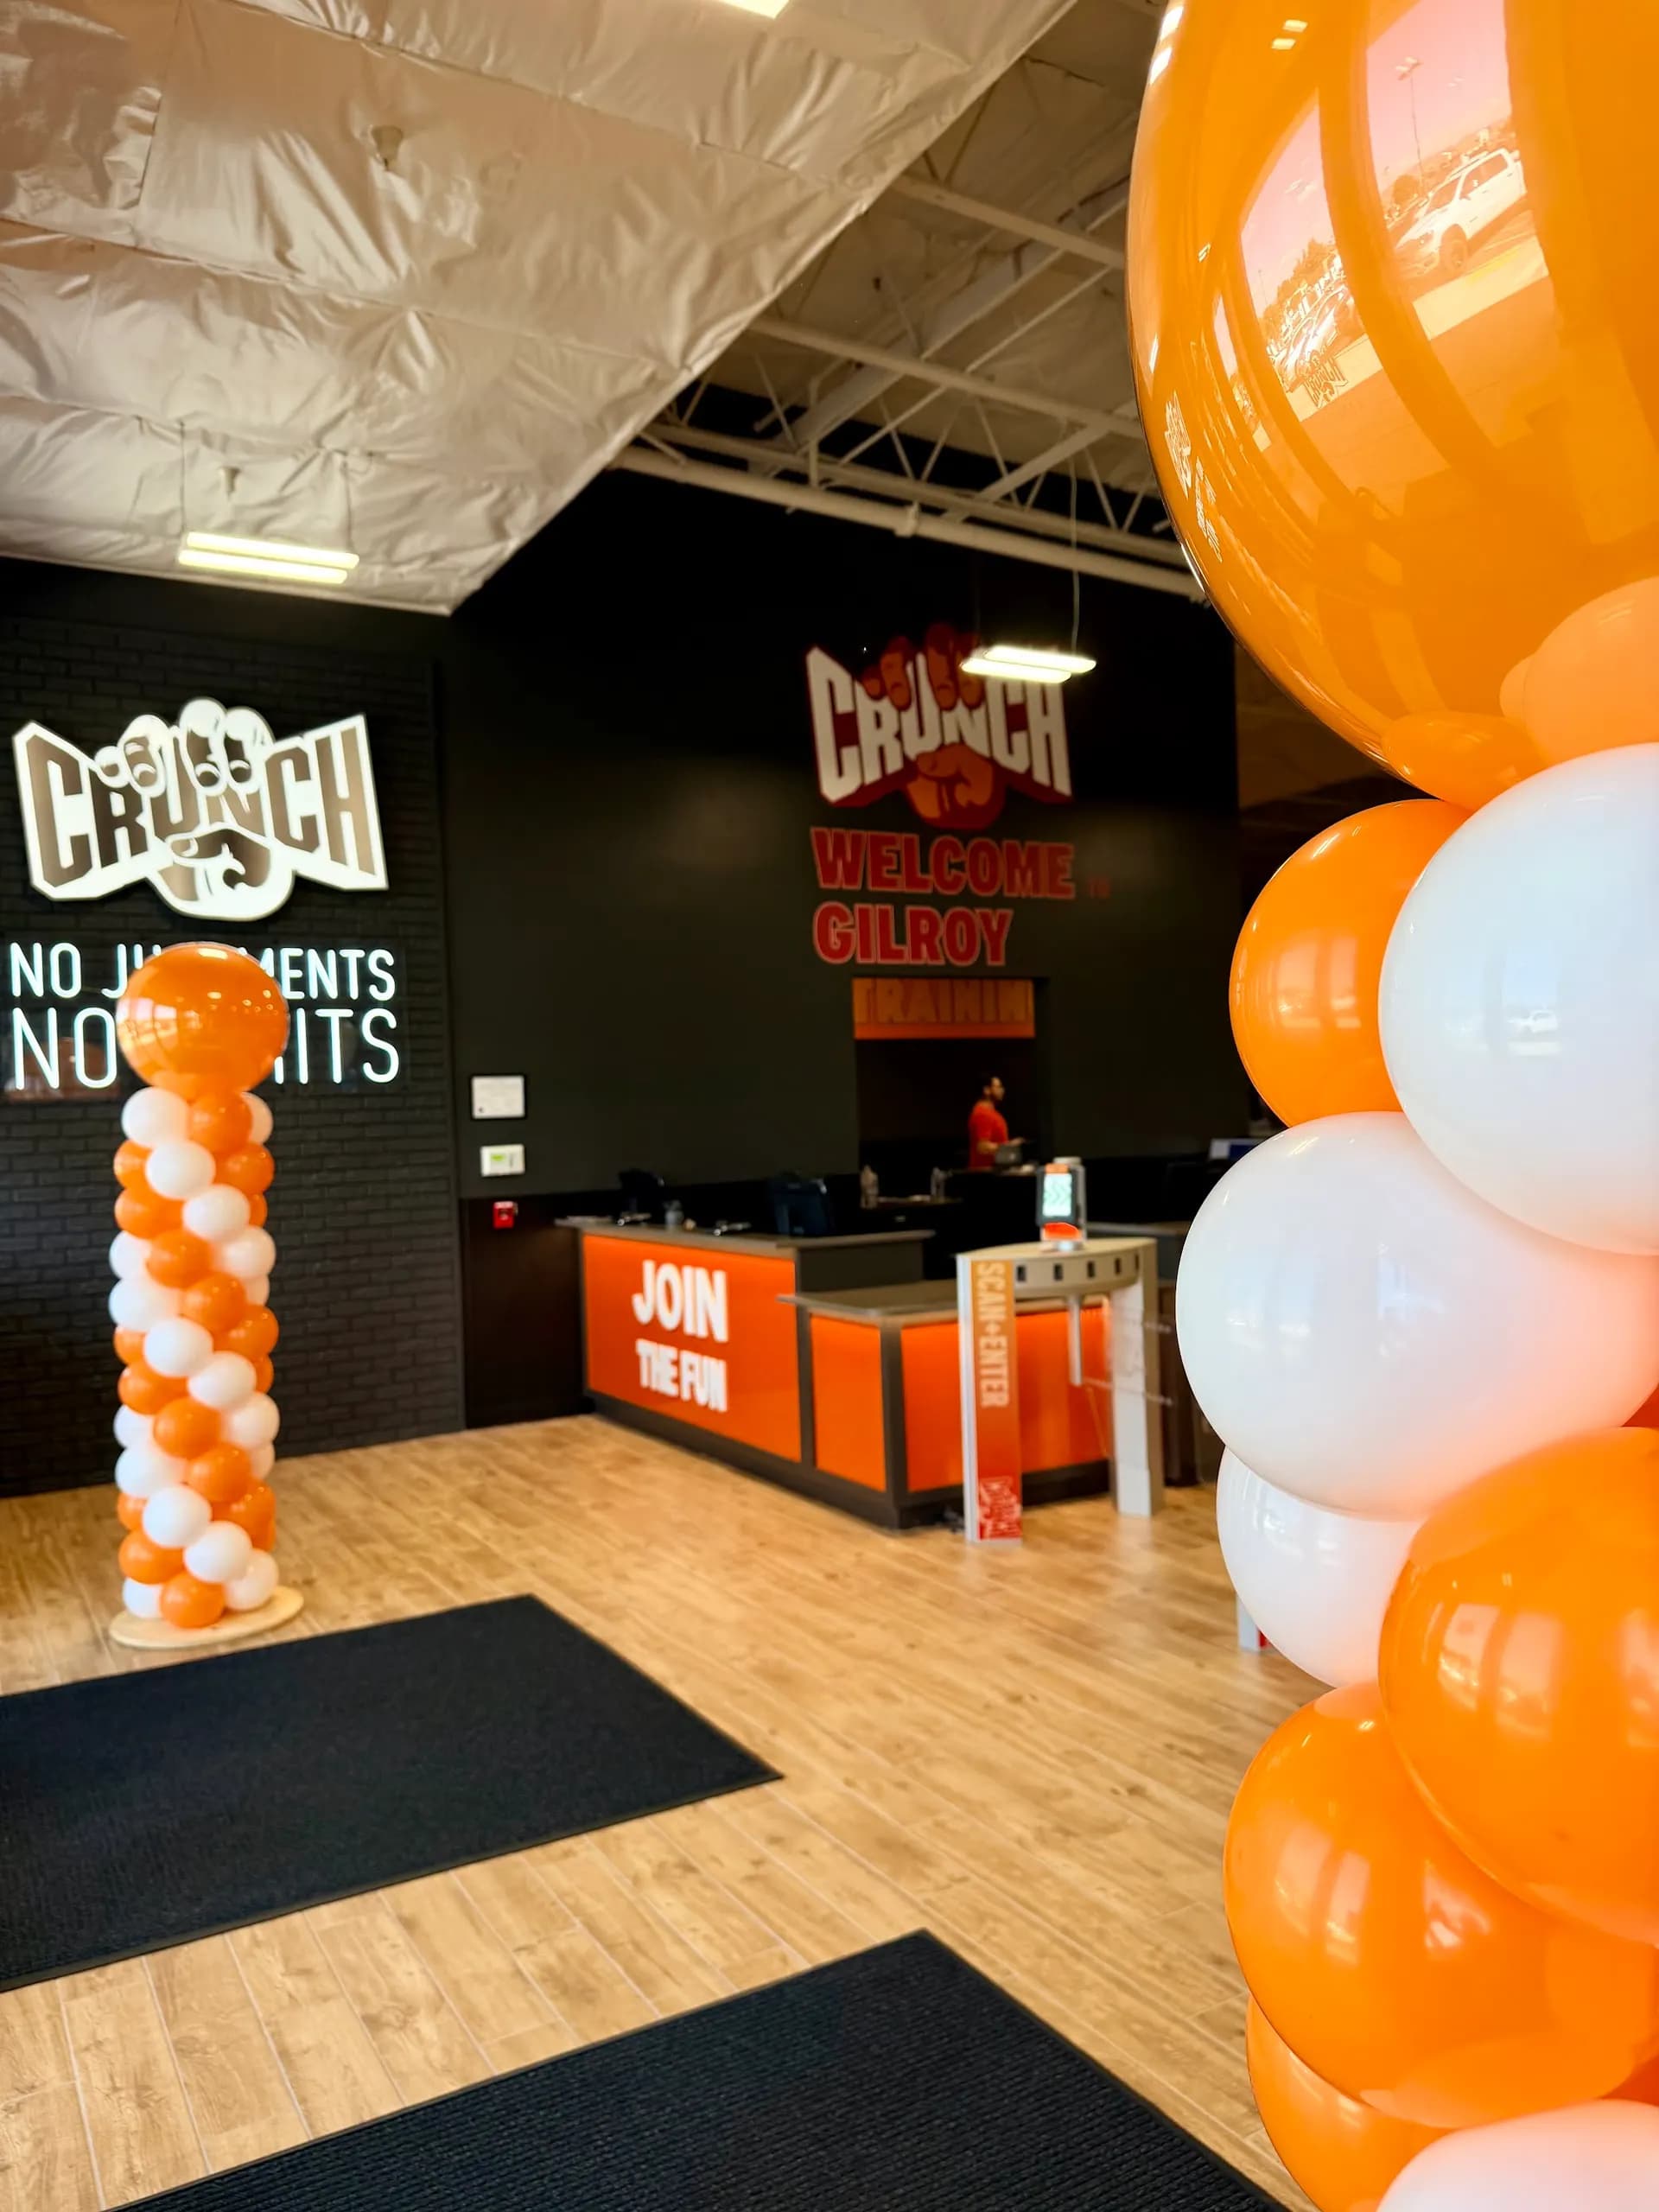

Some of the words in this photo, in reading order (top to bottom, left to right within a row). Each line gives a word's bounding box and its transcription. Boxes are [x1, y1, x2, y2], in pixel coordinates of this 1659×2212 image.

[806, 646, 1072, 804] CRUNCH
[25, 725, 377, 888] CRUNCH
[810, 826, 1076, 899] WELCOME
[10, 942, 82, 999] NO
[100, 943, 396, 1001] JENTS
[813, 900, 1014, 967] GILROY
[854, 978, 1034, 1024] TRAININ
[12, 1007, 118, 1090] NO
[274, 1007, 400, 1084] ITS
[632, 1259, 728, 1343] JOIN
[635, 1338, 678, 1397] THE
[680, 1349, 728, 1414] FUN
